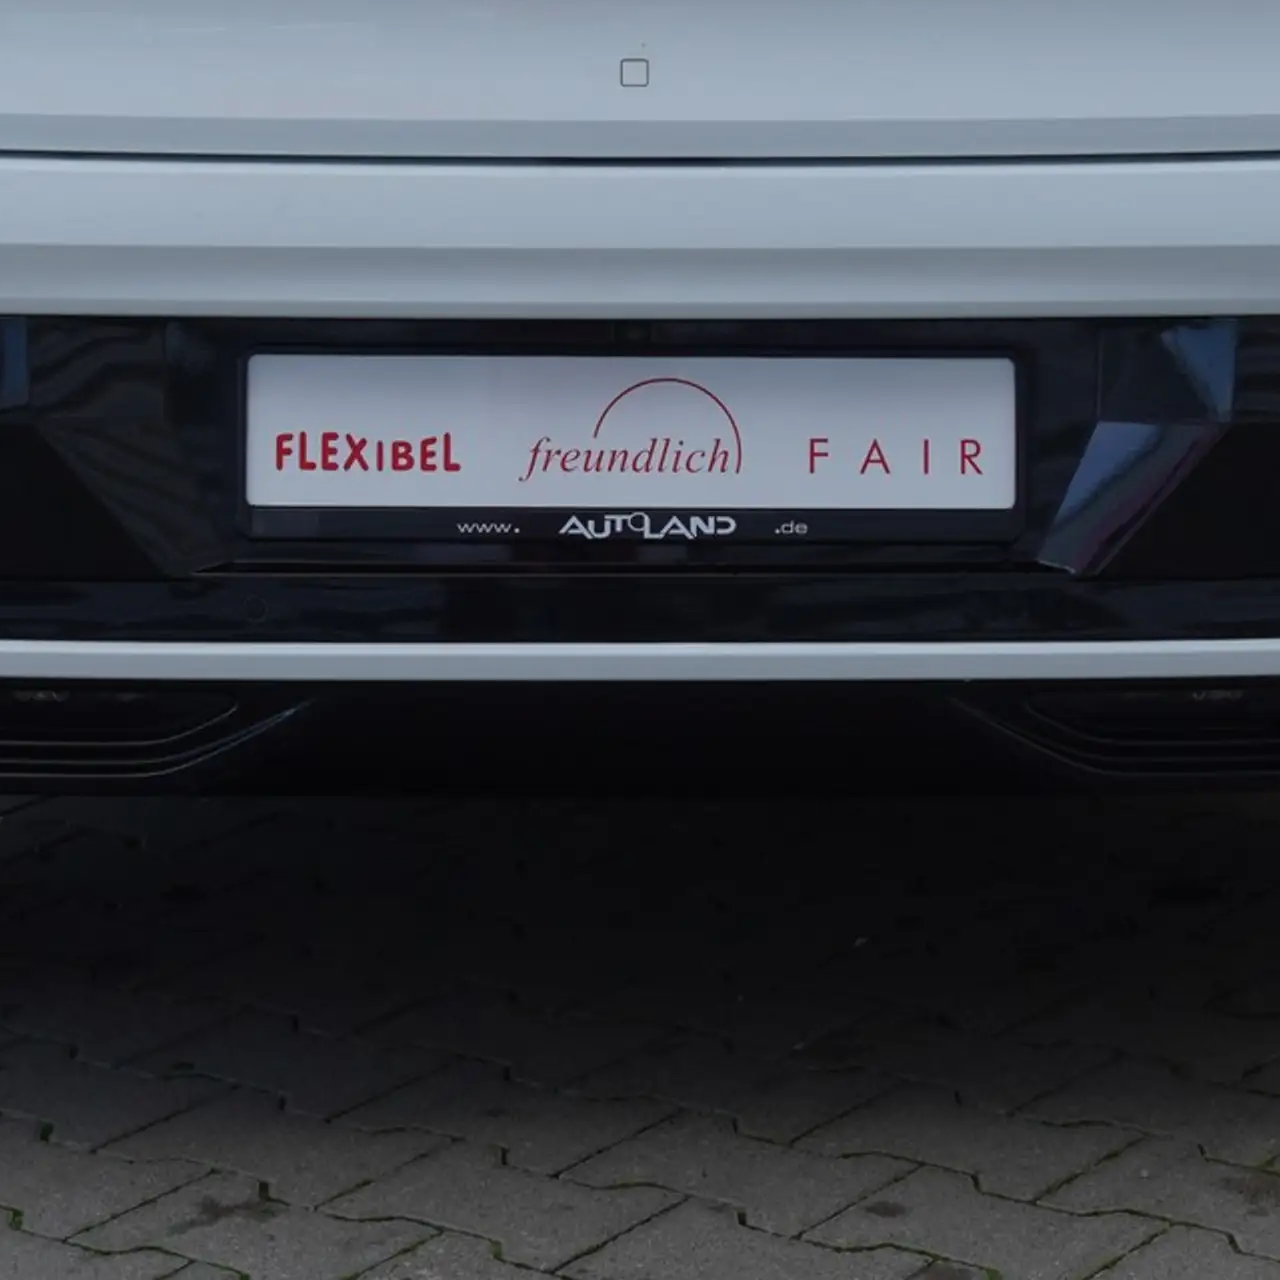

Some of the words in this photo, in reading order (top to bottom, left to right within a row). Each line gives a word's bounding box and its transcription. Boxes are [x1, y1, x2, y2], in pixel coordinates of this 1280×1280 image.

[275, 431, 461, 473] FLEXIBEL
[518, 435, 732, 483] freundlich
[807, 438, 984, 475] FAIR
[456, 522, 520, 535] www.
